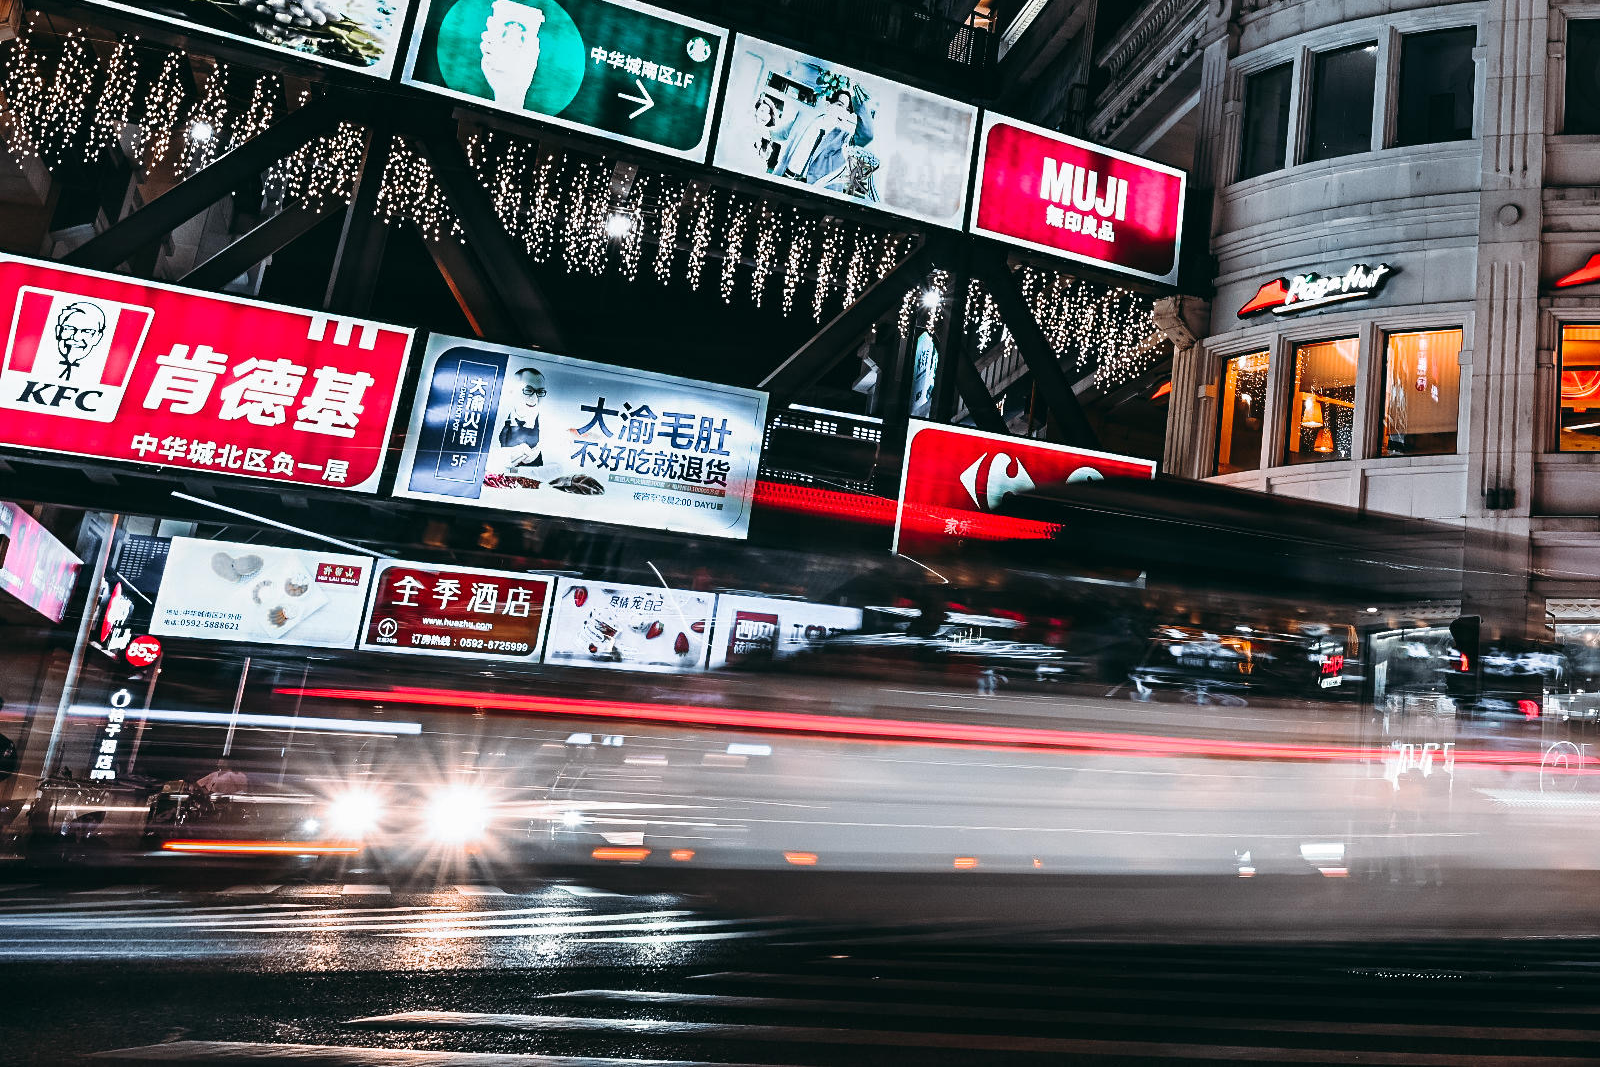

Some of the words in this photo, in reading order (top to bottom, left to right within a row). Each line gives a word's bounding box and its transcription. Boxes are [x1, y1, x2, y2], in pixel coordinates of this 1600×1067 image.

[590, 46, 695, 89] 中华城南区1F
[1040, 156, 1129, 221] MUJI
[1046, 206, 1115, 243] 無印良品
[16, 380, 103, 412] KFC
[142, 344, 375, 439] 肯德基
[459, 377, 488, 447] 大渝火锅
[576, 397, 733, 457] 大渝毛肚
[130, 432, 350, 484] 中华城北区负一层
[450, 454, 468, 468] 5F
[570, 439, 731, 488] 不好吃就退货
[391, 575, 534, 618] 全季酒店
[610, 595, 664, 612] 尽情宠自己
[422, 617, 493, 632] www.huazhu.com
